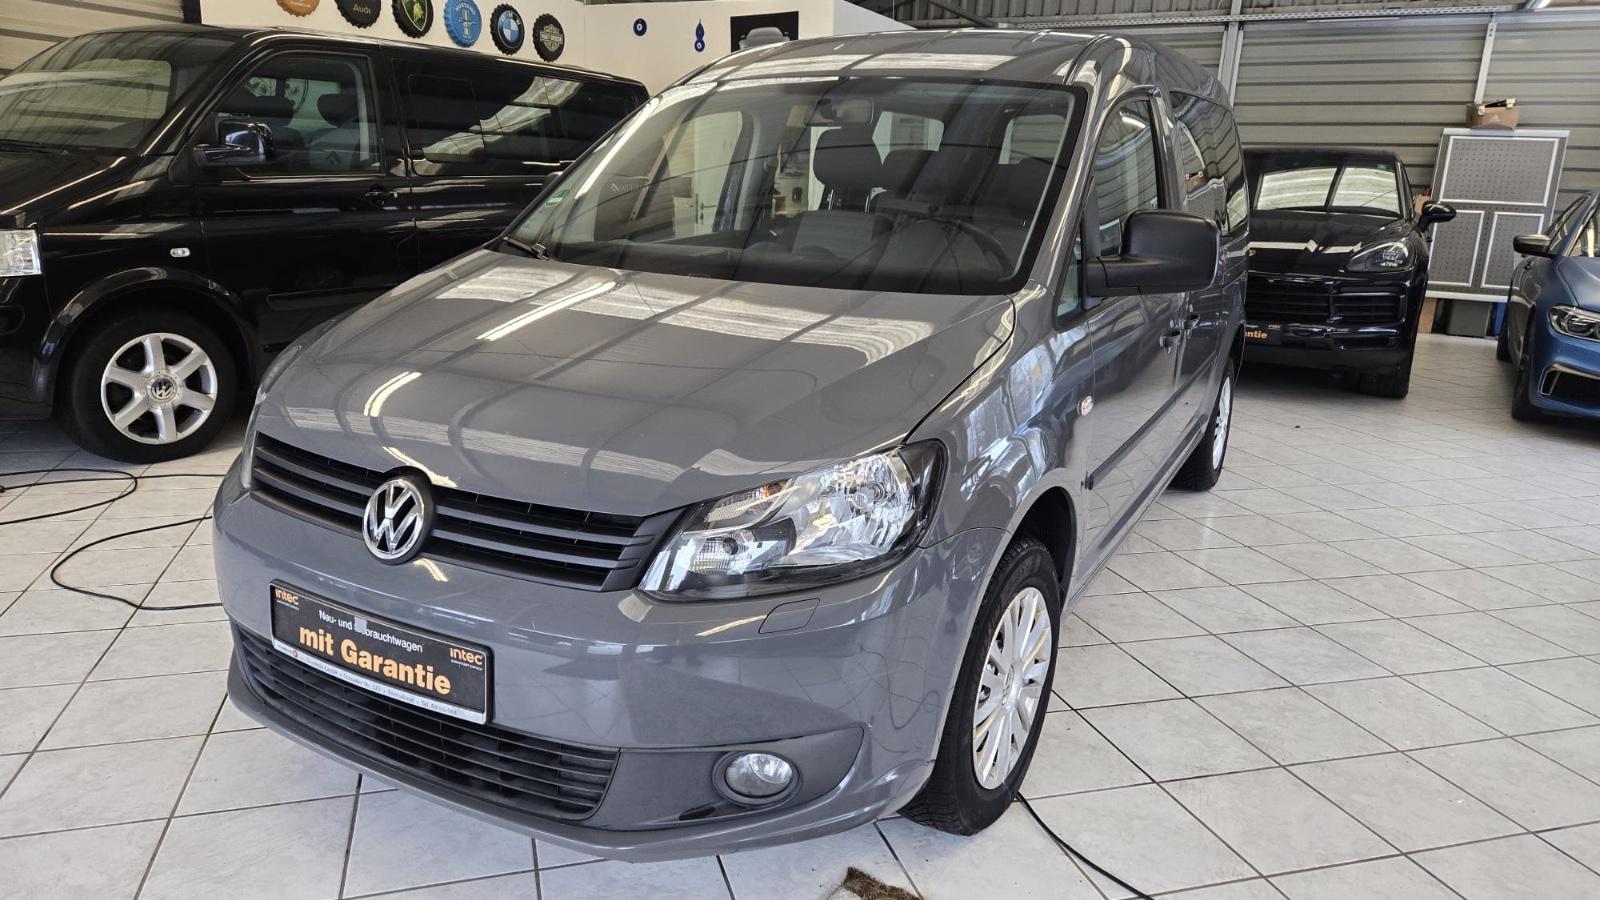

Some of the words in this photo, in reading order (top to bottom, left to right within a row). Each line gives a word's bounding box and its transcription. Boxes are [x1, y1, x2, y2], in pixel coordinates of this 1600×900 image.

[353, 4, 371, 14] Audi
[338, 619, 353, 630] und
[300, 626, 334, 656] mit
[341, 639, 451, 695] Garantie
